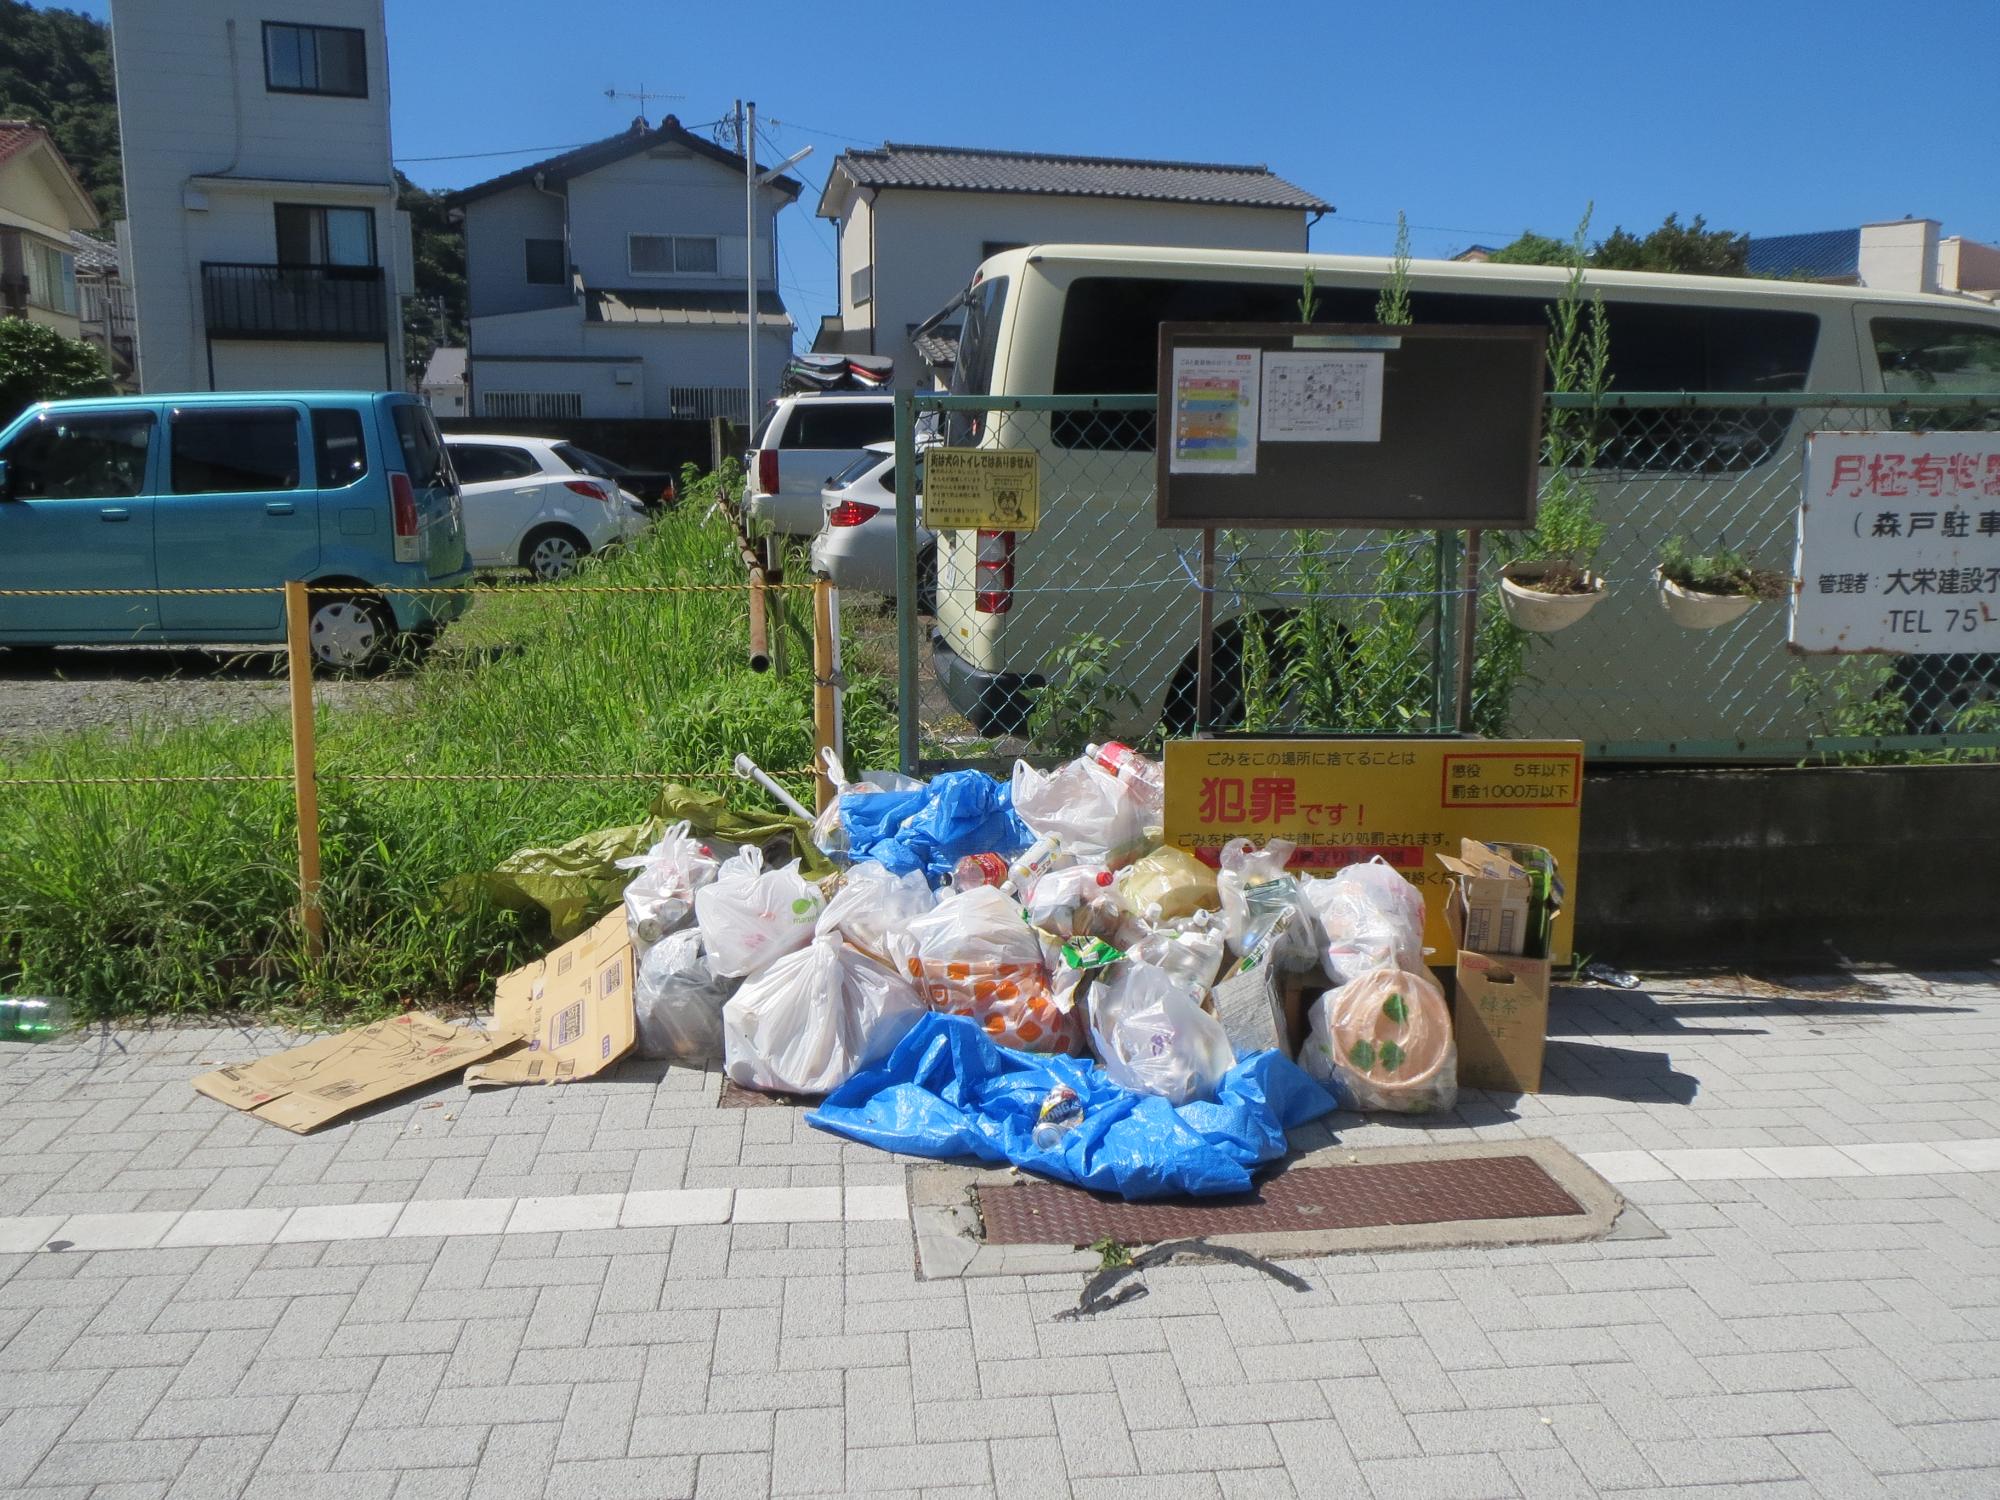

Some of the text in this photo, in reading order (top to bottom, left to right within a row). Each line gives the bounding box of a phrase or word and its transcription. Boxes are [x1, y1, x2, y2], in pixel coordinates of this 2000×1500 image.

[1889, 609, 1932, 633] TEL
[1207, 751, 1416, 767] ごみをこの場所に捨てることは
[1452, 763, 1569, 778] 懲役 5年以下
[1451, 784, 1569, 799] 罰金1000万以下
